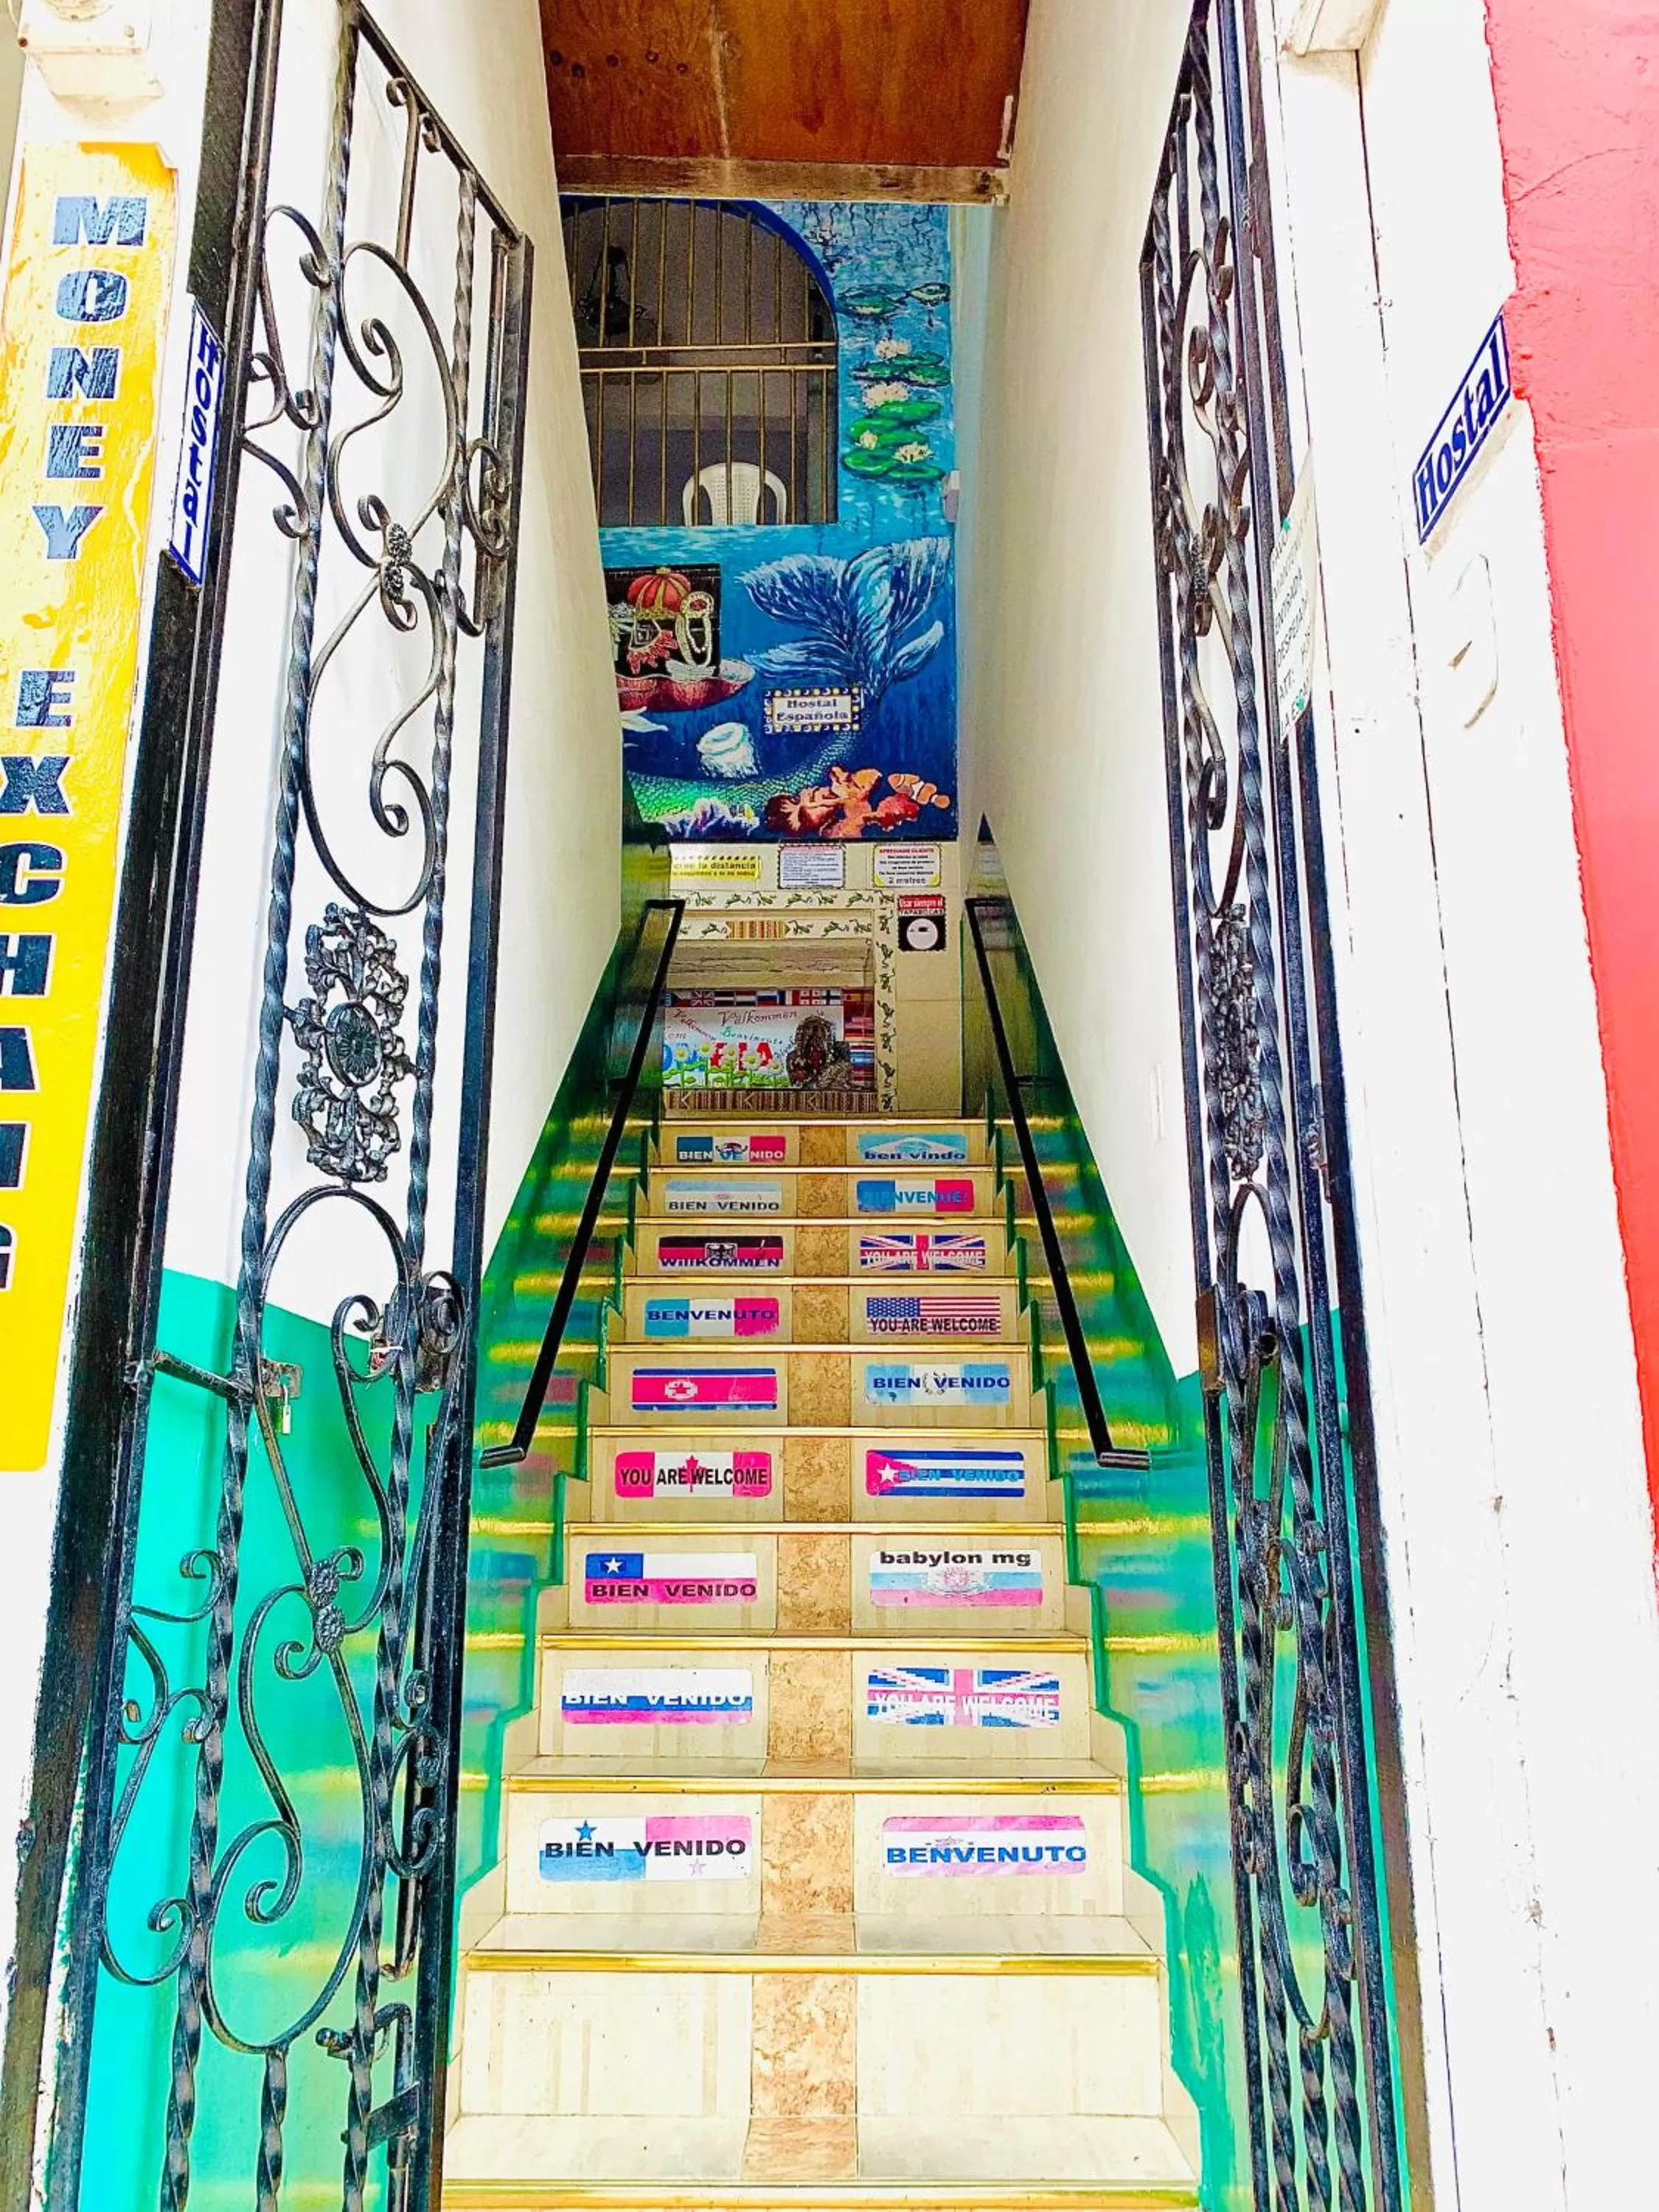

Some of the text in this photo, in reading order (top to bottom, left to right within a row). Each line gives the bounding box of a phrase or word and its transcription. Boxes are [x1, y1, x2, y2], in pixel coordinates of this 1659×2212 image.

[32, 195, 147, 560] MONEY
[1417, 332, 1504, 528] Hostal
[787, 698, 838, 709] Hostal
[776, 710, 849, 722] Española
[679, 1150, 712, 1160] BIEN
[750, 1150, 784, 1159] NIDO
[864, 1150, 965, 1160] ben vindo
[669, 1201, 779, 1211] BIEN VENIDO
[648, 1310, 773, 1321] BENVENUTO
[871, 1318, 996, 1332] YOU ARE WELCOME
[873, 1377, 1010, 1388] BIEN VENIDO
[620, 1468, 768, 1485] YOU ARE WELCOME
[898, 1469, 1020, 1481] BIEN VENIDO
[880, 1551, 1031, 1568] babylon mg
[592, 1585, 756, 1597] BIEN VENIDO
[545, 1840, 746, 1858] BIEN VENIDO
[886, 1846, 1086, 1864] BENVENUTO
